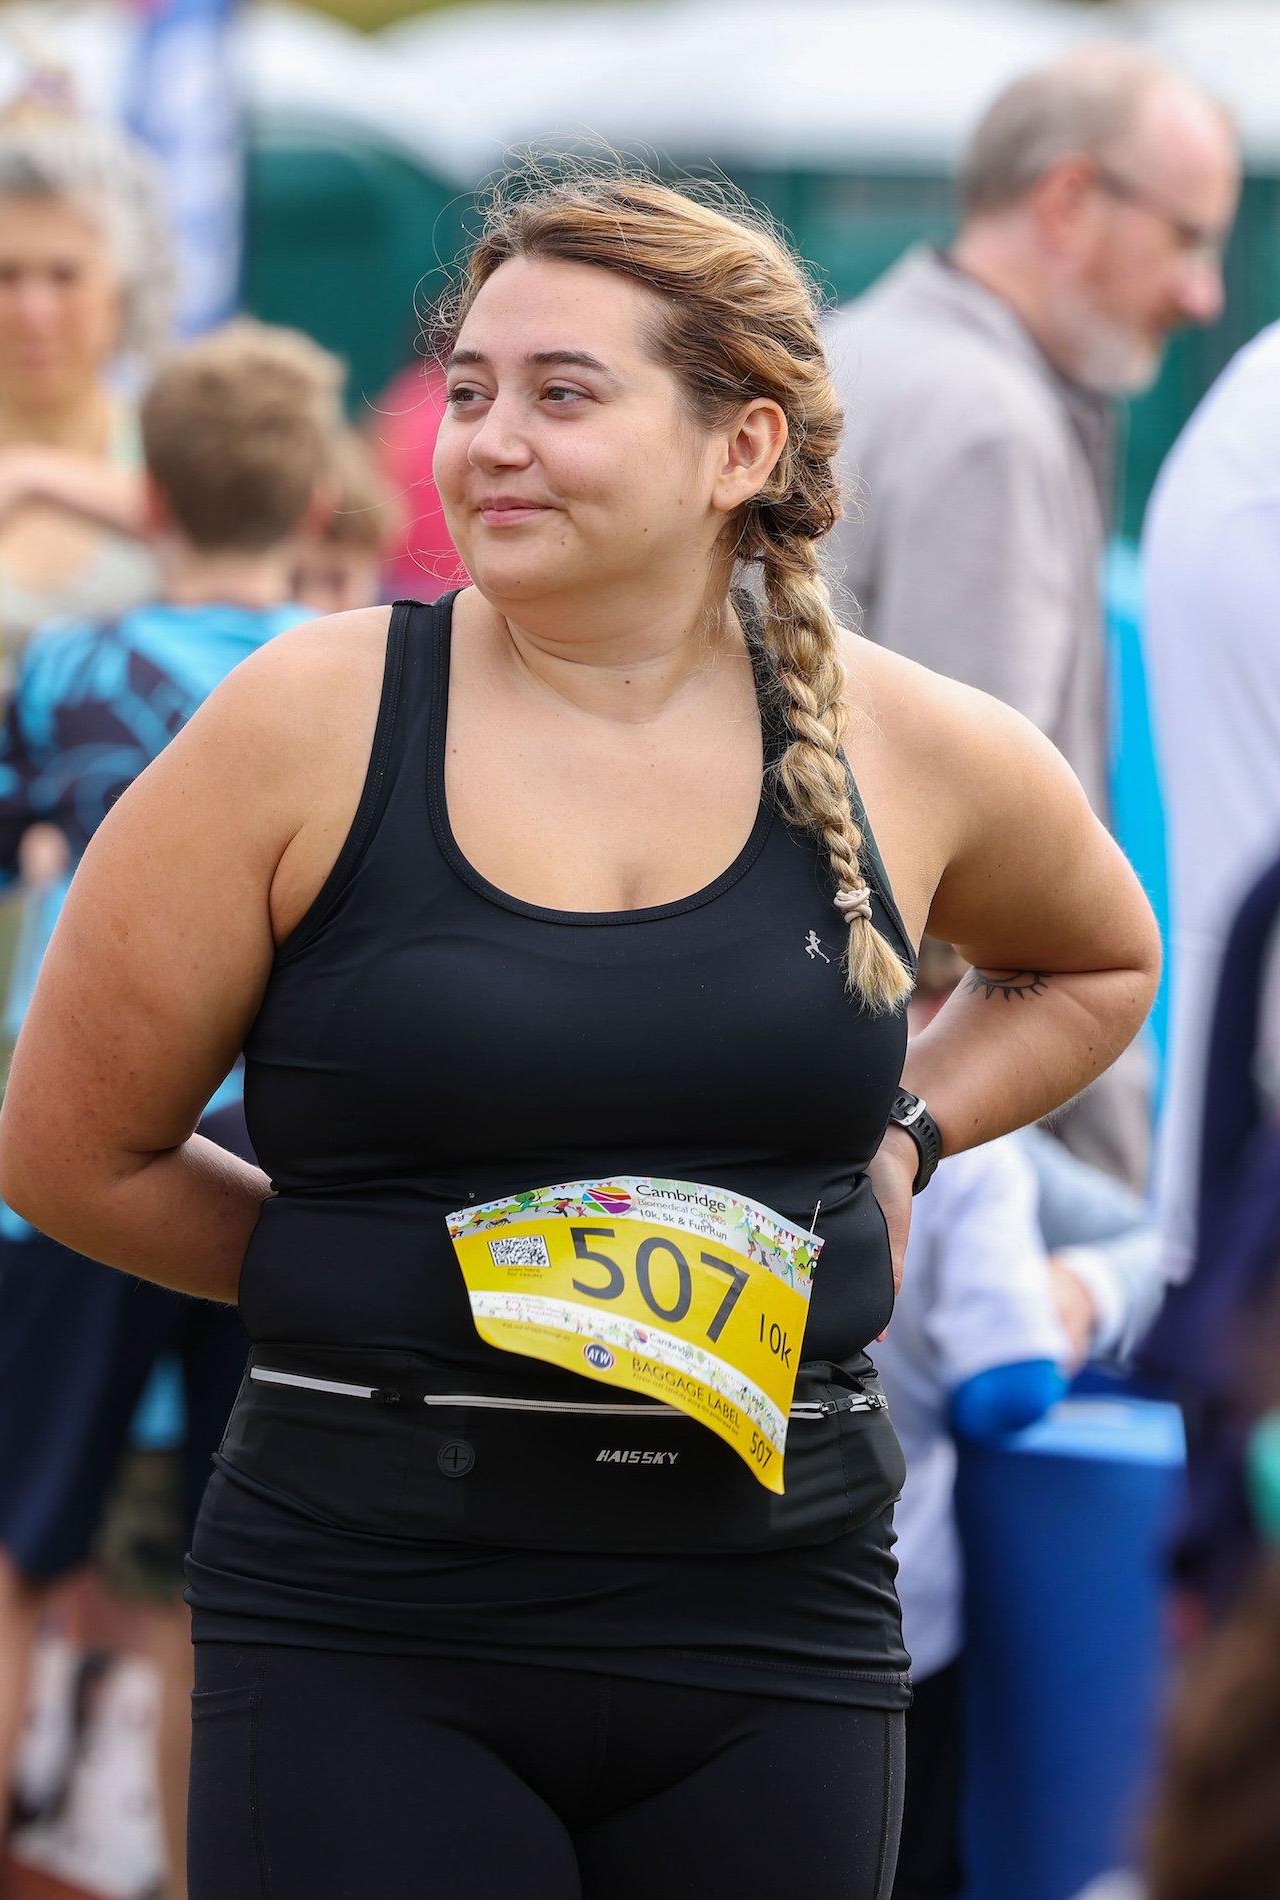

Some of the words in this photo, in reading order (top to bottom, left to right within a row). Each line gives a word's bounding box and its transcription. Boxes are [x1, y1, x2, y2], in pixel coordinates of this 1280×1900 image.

[636, 1184, 726, 1213] Cambridge
[638, 1198, 688, 1214] Biomedical
[690, 1207, 726, 1226] Campus
[662, 1213, 675, 1223] 5k
[677, 1216, 686, 1226] &
[689, 1219, 707, 1232] Fun
[709, 1224, 727, 1240] Run
[569, 1227, 750, 1344] 507
[759, 1312, 793, 1369] 10k
[587, 1348, 610, 1365] ATW
[632, 1357, 704, 1399] BAGGAGE
[708, 1393, 740, 1429] LABEL
[596, 1450, 679, 1465] HAISSKY
[749, 1431, 773, 1469] 507
